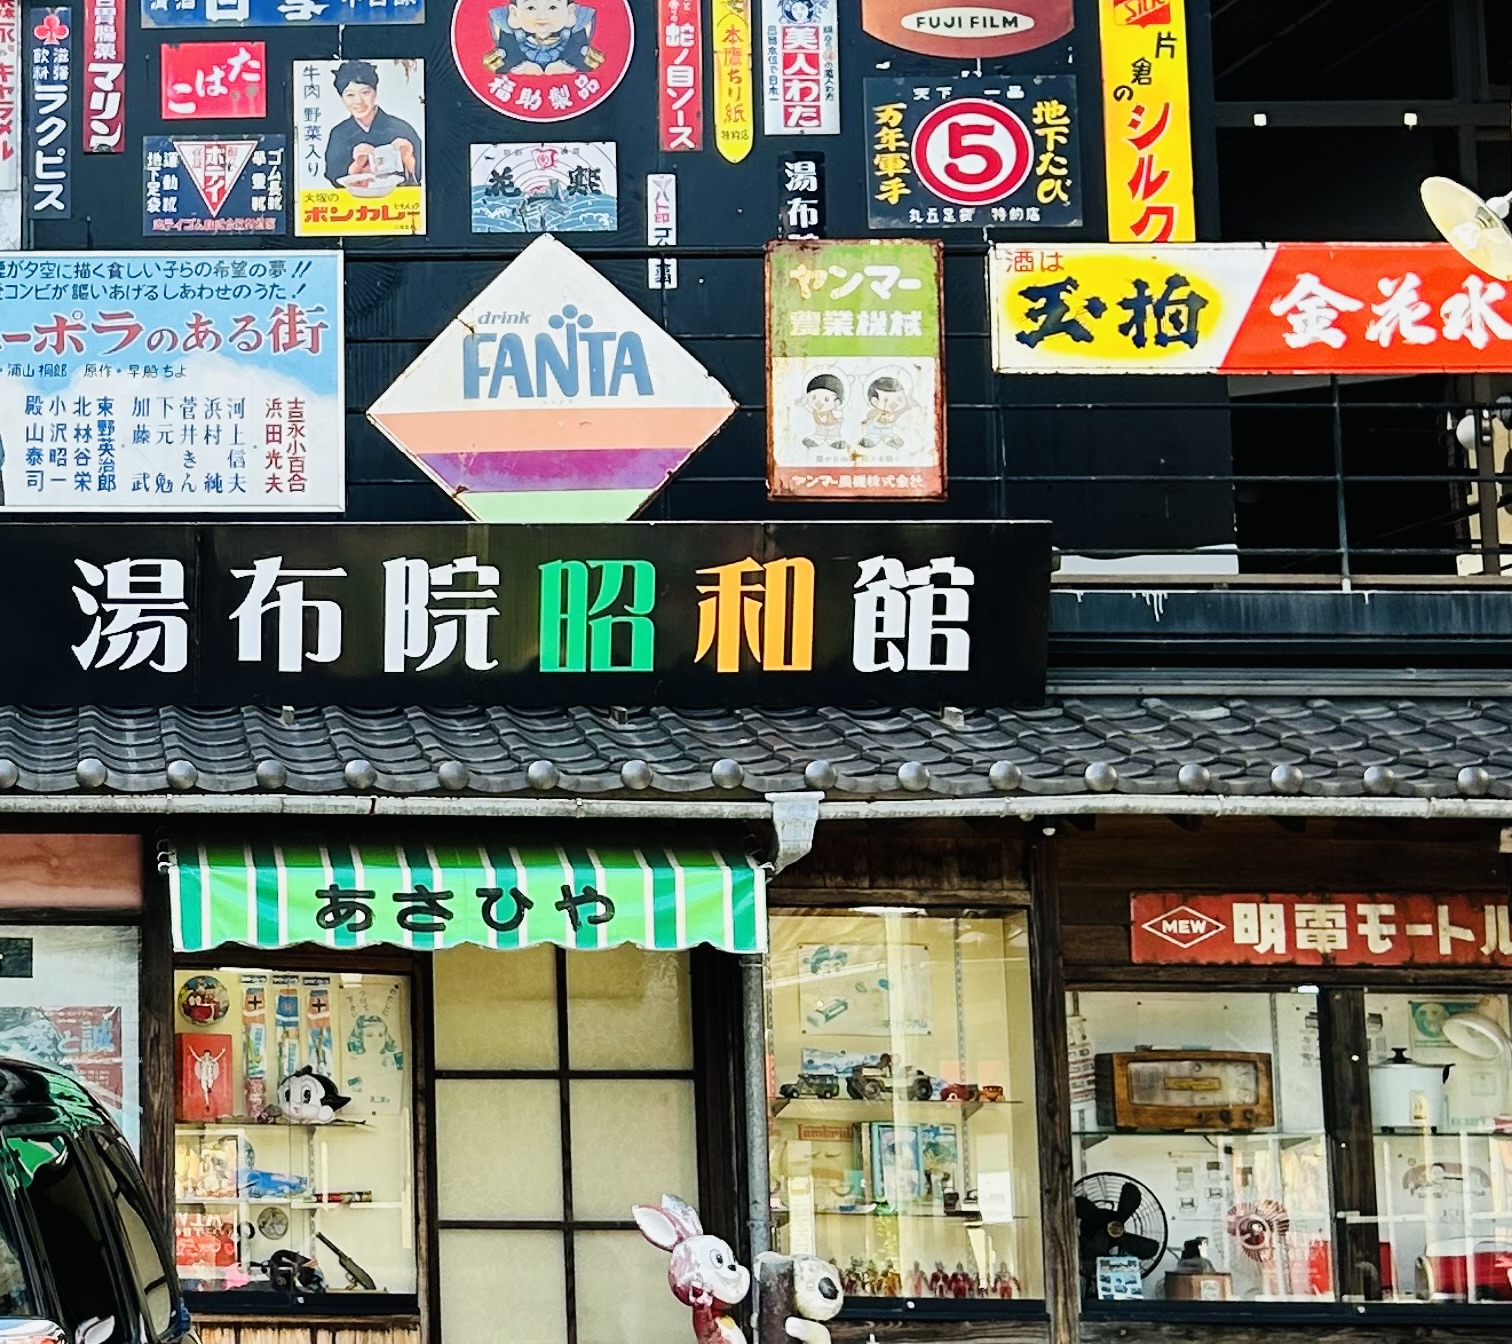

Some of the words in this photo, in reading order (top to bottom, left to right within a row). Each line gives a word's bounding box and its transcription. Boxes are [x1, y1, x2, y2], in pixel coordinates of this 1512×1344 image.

[916, 15, 963, 29] FUJI
[970, 15, 1019, 29] FILM
[88, 62, 125, 149] マリン
[168, 46, 262, 115] たばこ
[302, 64, 321, 99] 牛肉
[488, 74, 601, 112] 福助製品
[664, 22, 696, 150] 蛇ノ目ソース
[783, 26, 822, 128] 美人わた
[1113, 31, 1178, 102] 片倉の
[33, 84, 68, 211] ラクピス
[303, 107, 323, 178] 野菜入り
[873, 102, 912, 205] 万年軍手
[944, 121, 1004, 186] 5
[1031, 99, 1073, 207] 地下たび
[1126, 102, 1175, 242] シルク
[304, 204, 421, 223] ボンカレー
[785, 160, 820, 240] 湯布
[790, 263, 922, 301] ヤンマー
[1004, 252, 1065, 274] 酒は
[463, 322, 655, 400] FANTA
[478, 311, 532, 325] drink
[790, 309, 923, 337] 農業機械
[24, 395, 45, 493] 殿山泰司
[49, 396, 68, 483] 小沢昭一
[72, 395, 92, 492] 北林谷栄
[96, 395, 117, 492] 東野英治郎
[131, 395, 151, 494] 加藤武
[179, 396, 197, 493] 菅井きん
[203, 396, 224, 494] 浜村純
[226, 396, 247, 494] 河上信夫
[264, 397, 284, 494] 浜田光夫
[286, 397, 307, 494] 吉永小百合
[70, 554, 977, 674] 湯布院昭和館
[314, 882, 616, 933] あさひや
[1161, 919, 1208, 935] MEW
[1232, 902, 1512, 956] 明電モートル
